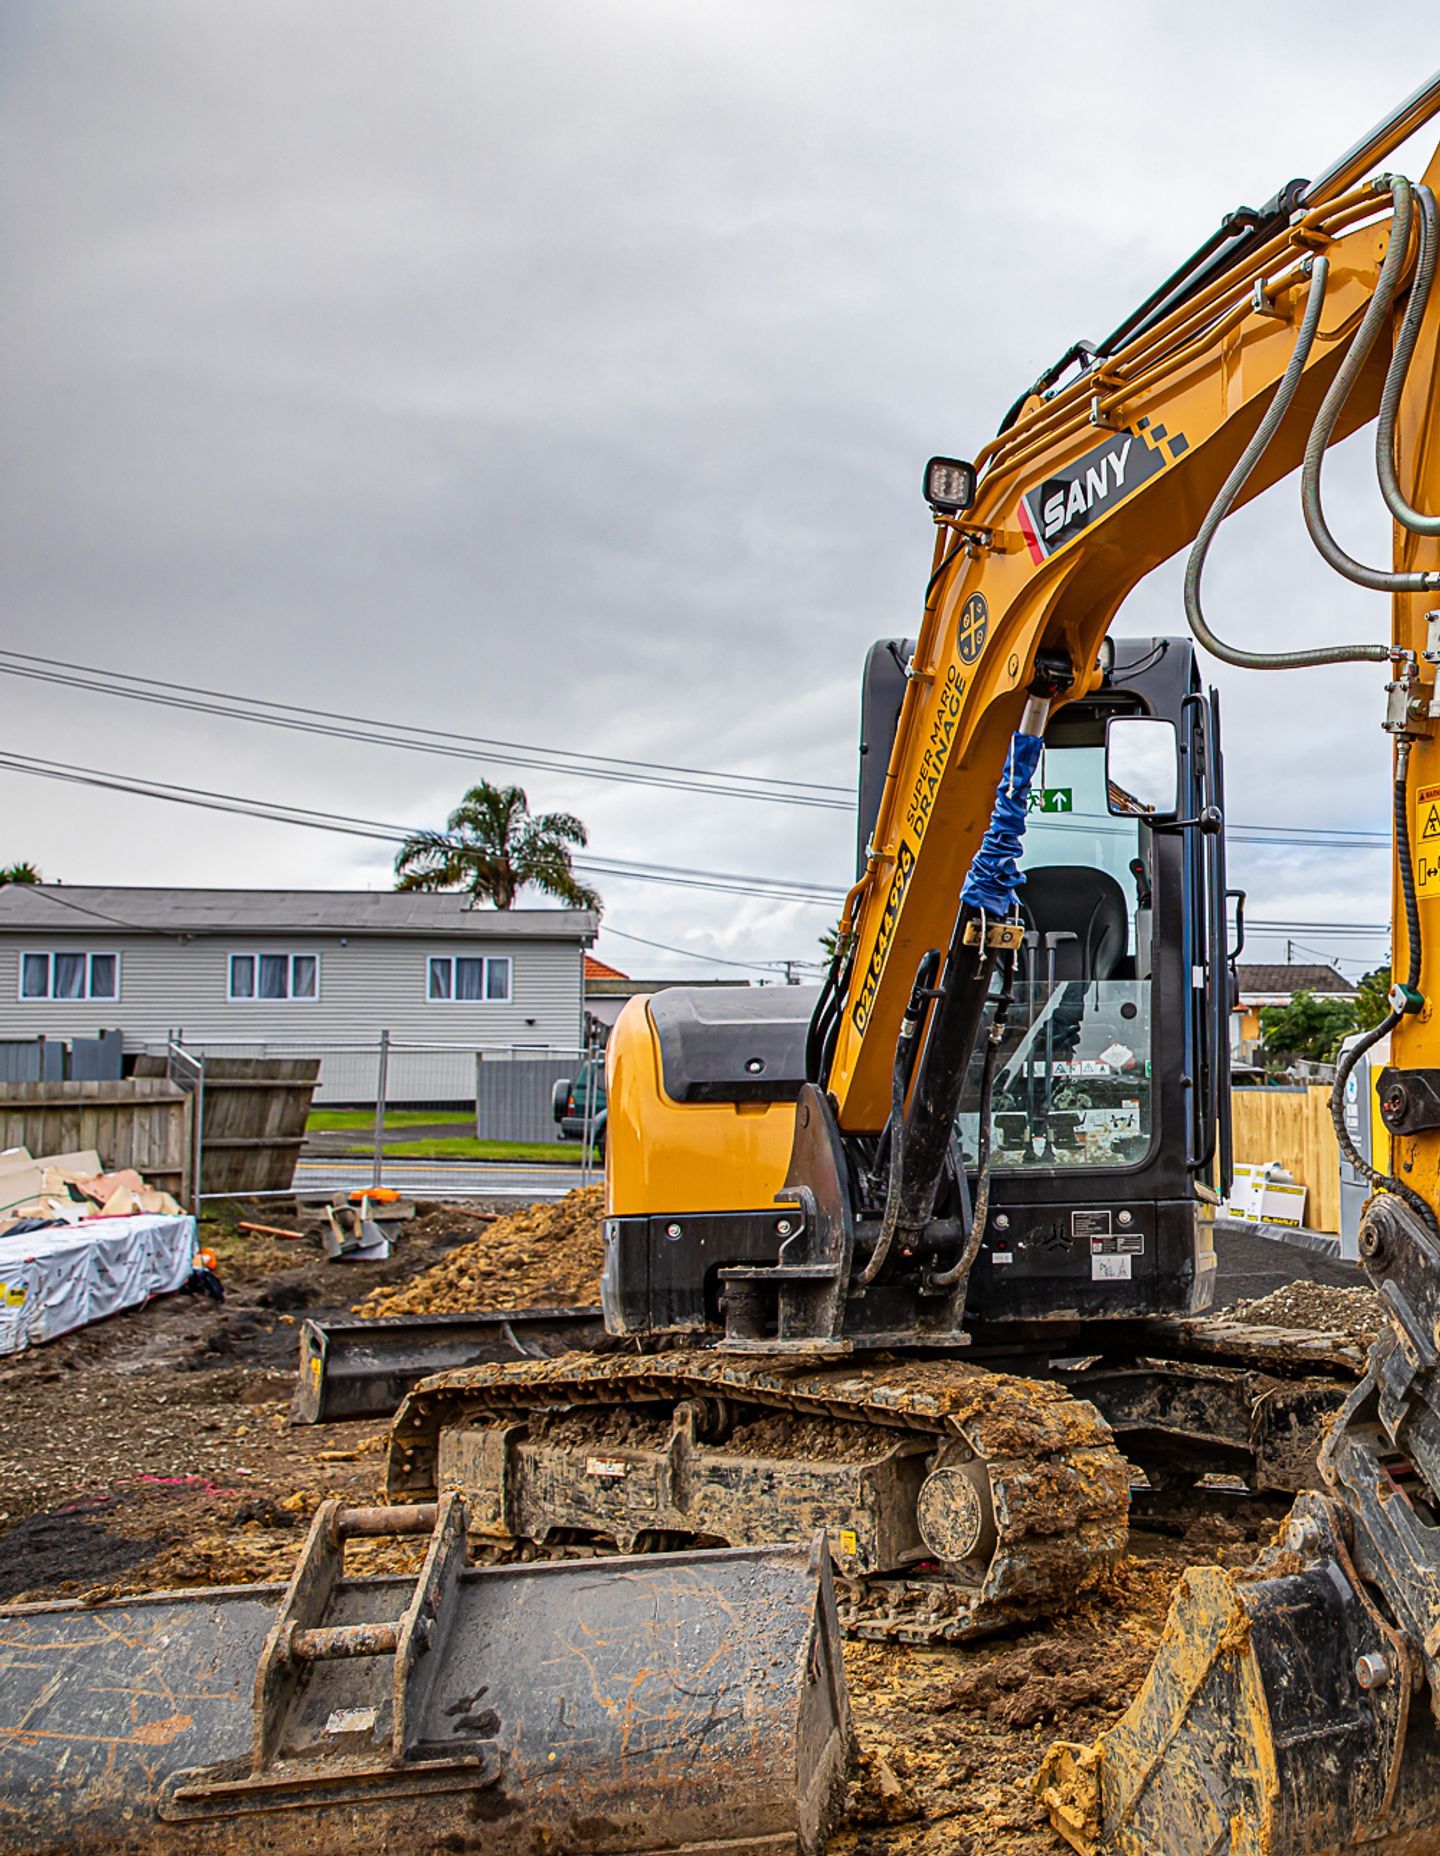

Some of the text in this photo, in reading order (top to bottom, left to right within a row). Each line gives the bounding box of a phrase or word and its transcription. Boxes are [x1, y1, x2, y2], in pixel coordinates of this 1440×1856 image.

[1043, 438, 1132, 540] SANY
[906, 664, 956, 828] SUPER MARIO
[913, 672, 966, 841] DRAINAGE
[855, 850, 912, 1030] 021 644 996
